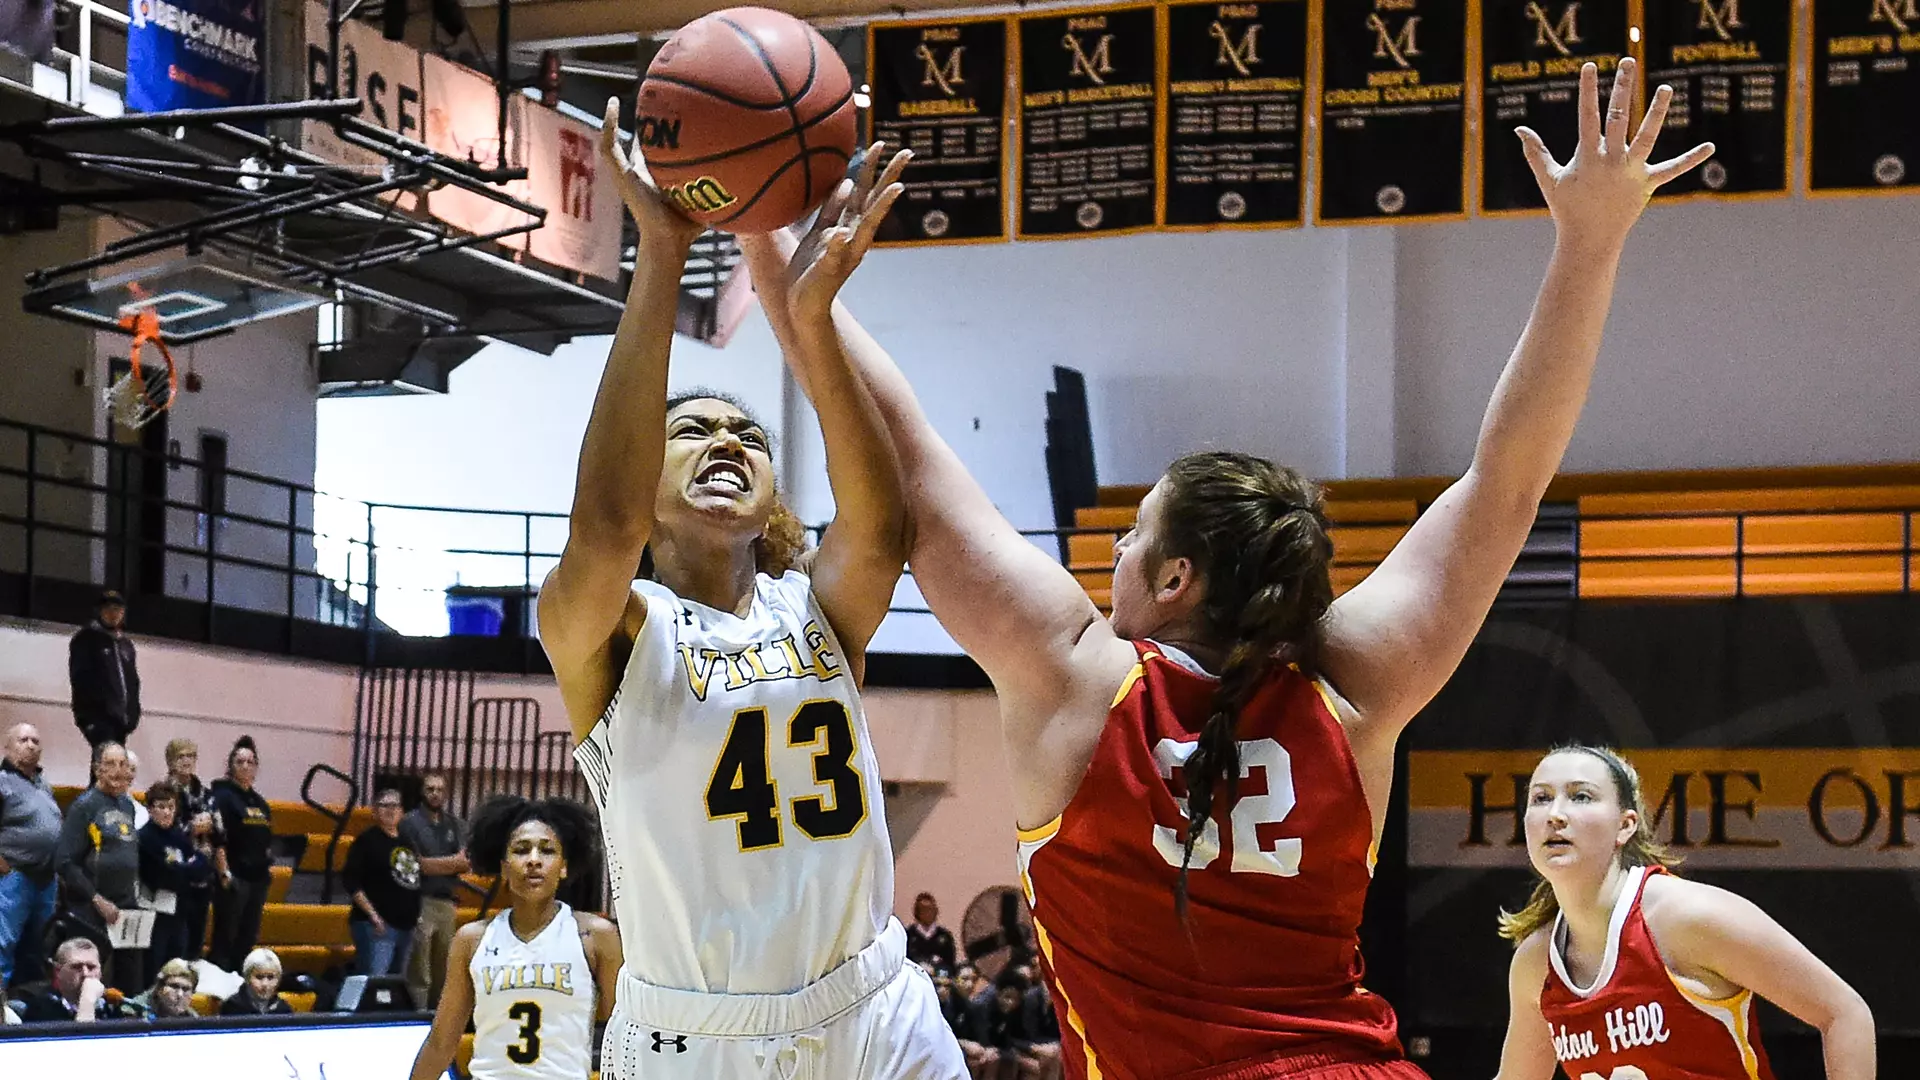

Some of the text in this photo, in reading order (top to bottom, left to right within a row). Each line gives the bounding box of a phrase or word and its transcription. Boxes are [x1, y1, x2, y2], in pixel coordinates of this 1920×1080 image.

[155, 0, 257, 61] BENCHMARK
[1672, 41, 1761, 63] FOOTBALL
[1068, 83, 1154, 103] BASKETBALL
[1325, 83, 1463, 105] CROSS COUNTRY
[1490, 61, 1541, 81] FIELD
[898, 98, 979, 117] BASEBALL
[677, 619, 844, 702] VILLE
[703, 698, 869, 854] 43
[1151, 737, 1303, 878] 32
[1459, 768, 1781, 851] HME
[482, 962, 574, 997] VILLE
[507, 1000, 542, 1065] 3
[1605, 1001, 1671, 1054] Hill
